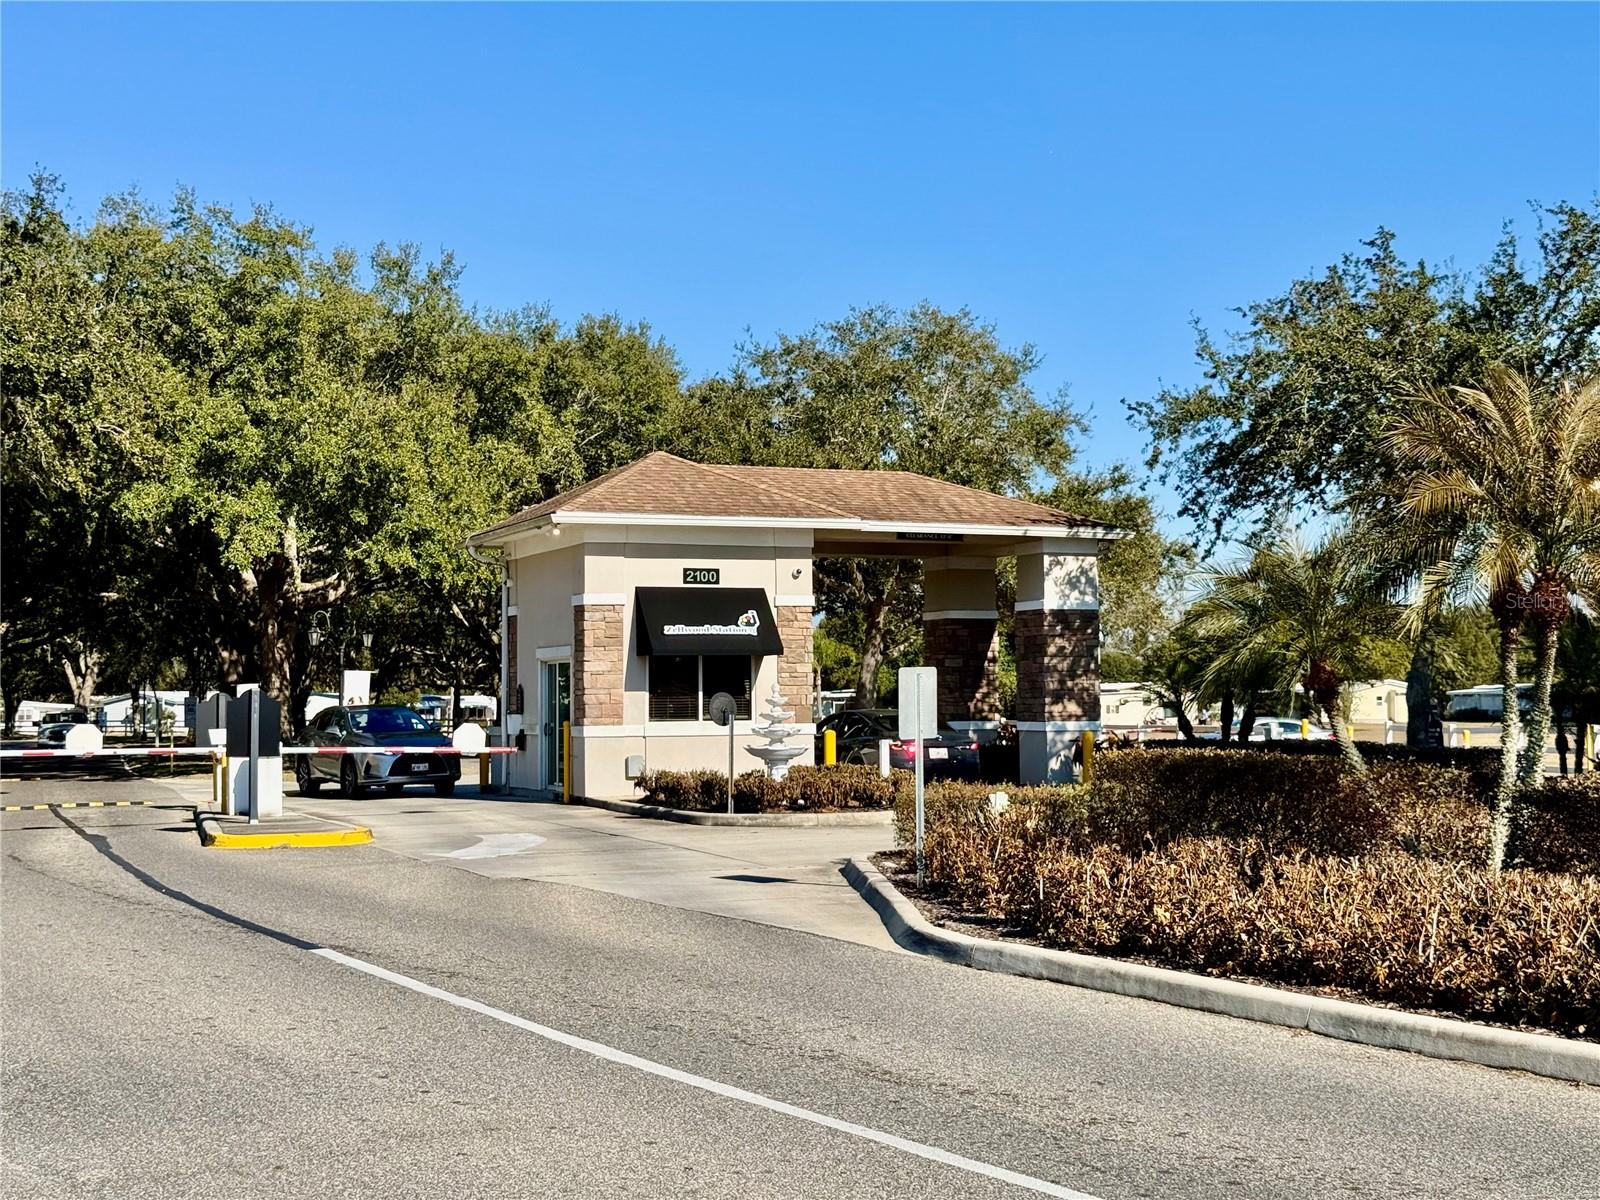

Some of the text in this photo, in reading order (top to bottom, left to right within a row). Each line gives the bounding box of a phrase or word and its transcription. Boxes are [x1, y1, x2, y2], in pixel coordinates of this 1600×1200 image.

[686, 570, 717, 582] 2100
[664, 624, 748, 634] Zellwood Station
